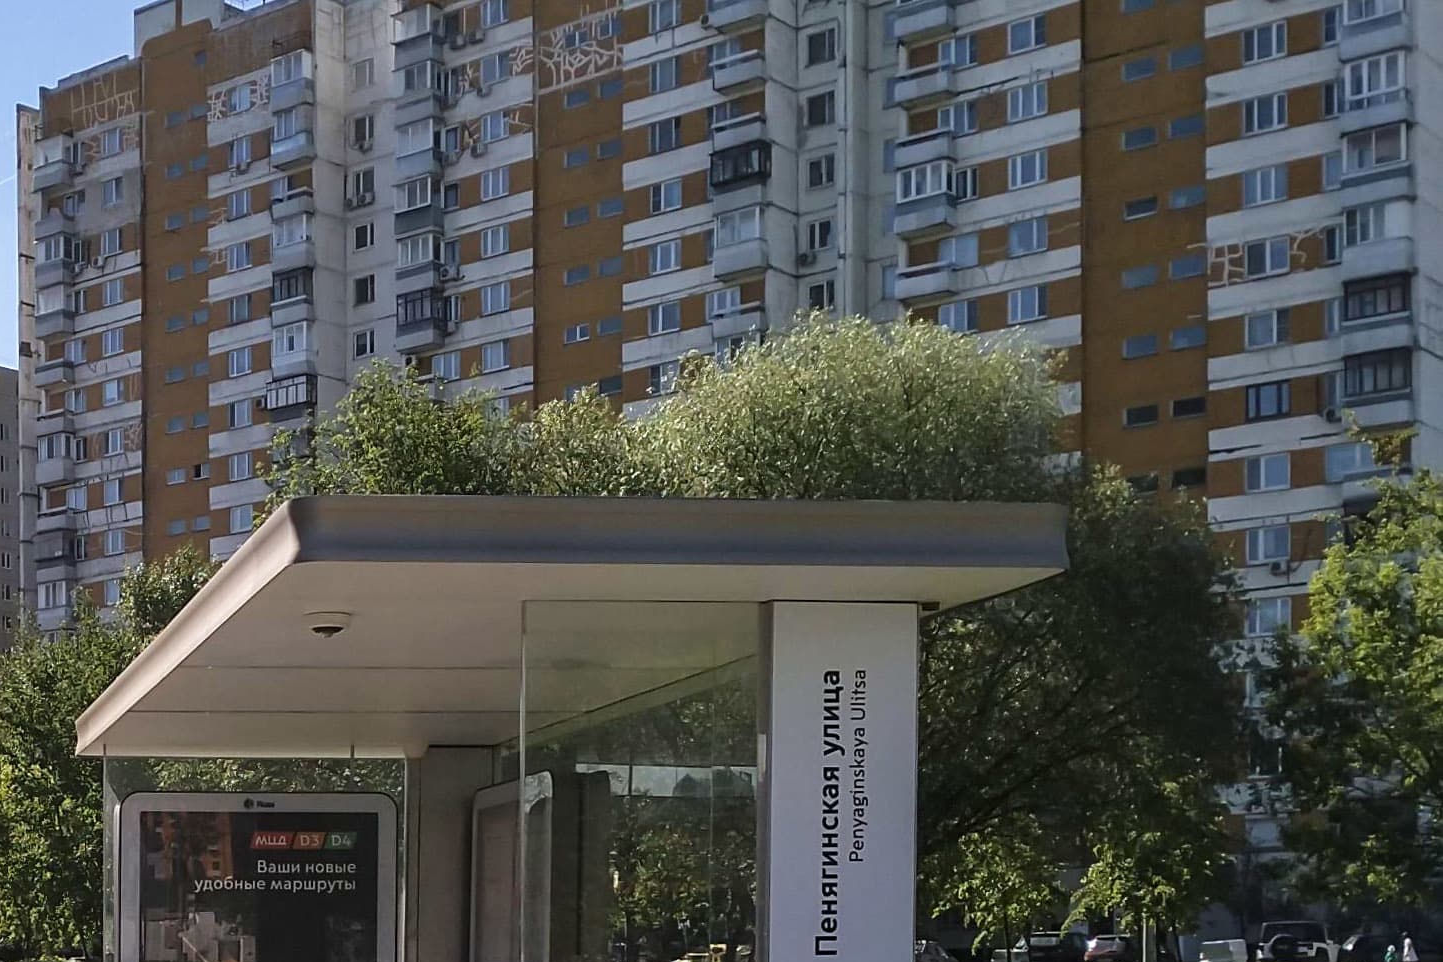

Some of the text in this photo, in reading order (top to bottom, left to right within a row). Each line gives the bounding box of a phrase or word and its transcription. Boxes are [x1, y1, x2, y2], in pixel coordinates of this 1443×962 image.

[849, 669, 869, 862] Penyaginskaya Ulitsa
[815, 670, 845, 956] Пенягинская улица
[254, 835, 352, 846] МЦД D3 D4
[257, 859, 357, 874] Ваши новые
[194, 875, 356, 894] удобные маршруты
